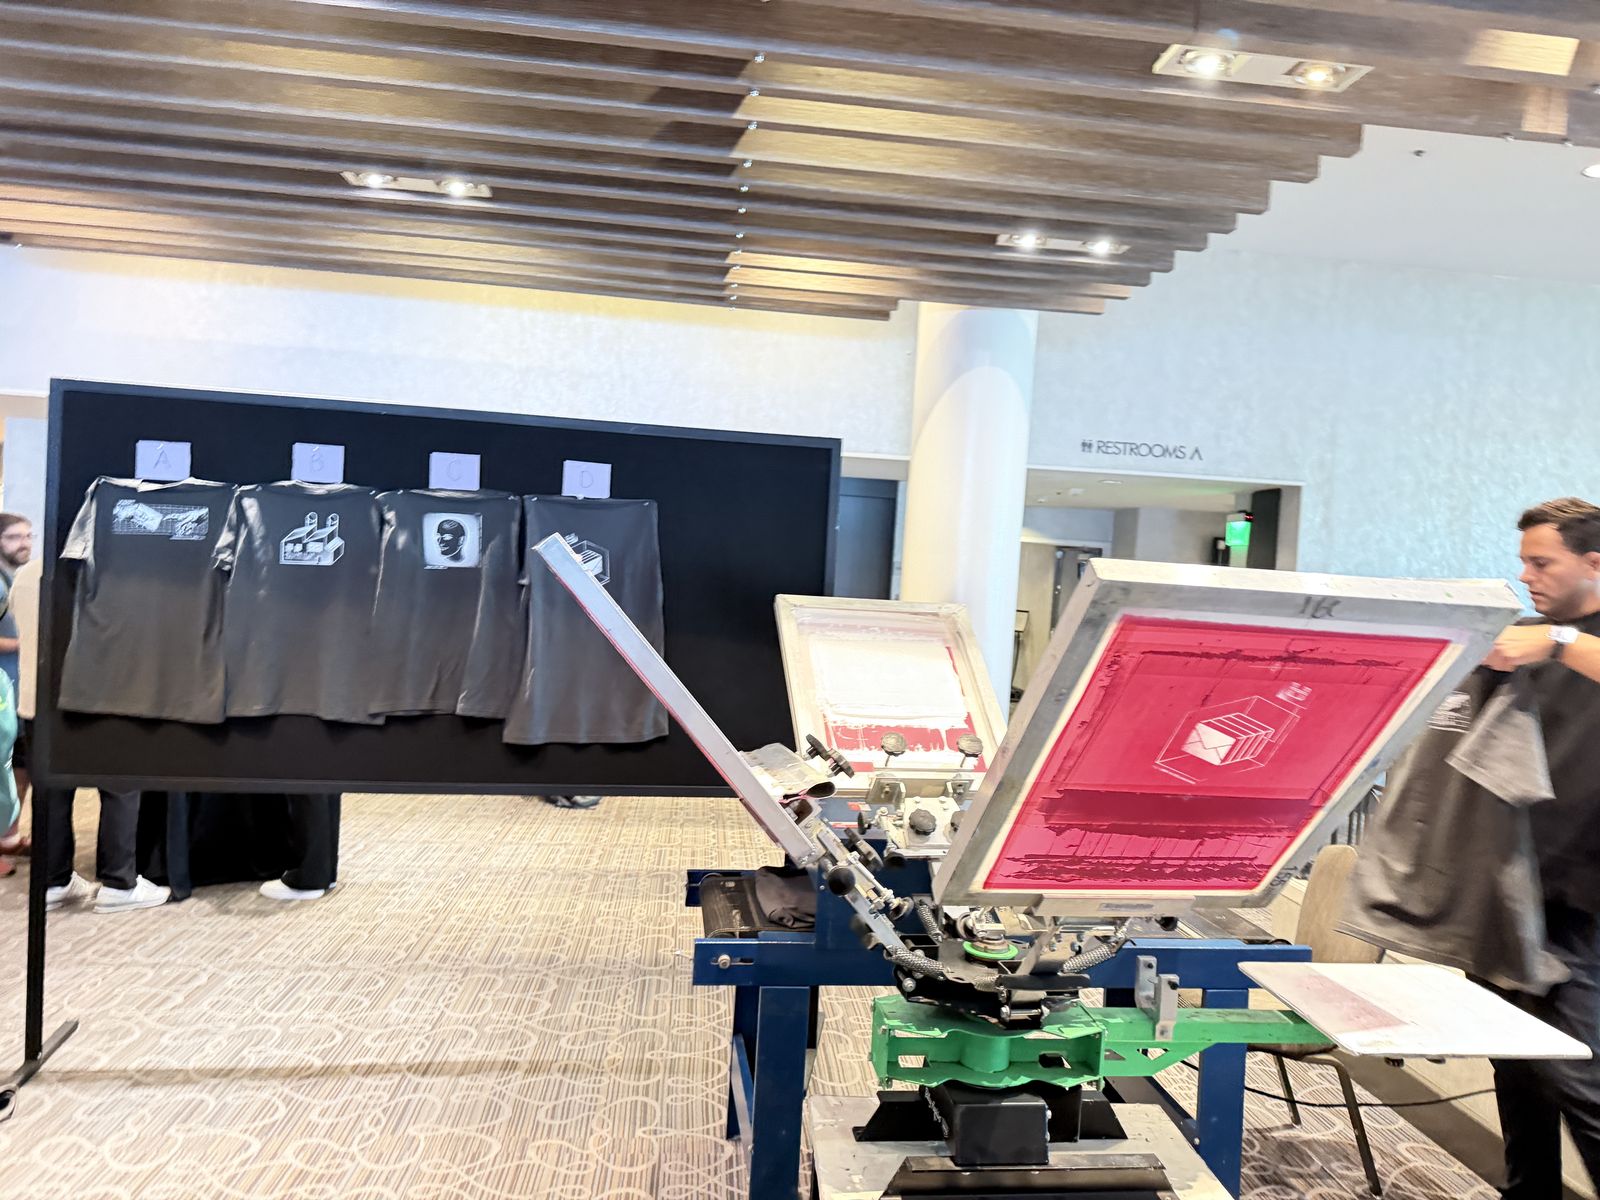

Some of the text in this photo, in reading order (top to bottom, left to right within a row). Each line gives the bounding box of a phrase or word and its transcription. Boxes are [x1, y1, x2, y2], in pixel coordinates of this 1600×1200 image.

[153, 450, 172, 469] A
[1096, 440, 1187, 460] RESTROOMS
[311, 453, 325, 472] B
[580, 470, 594, 489] D
